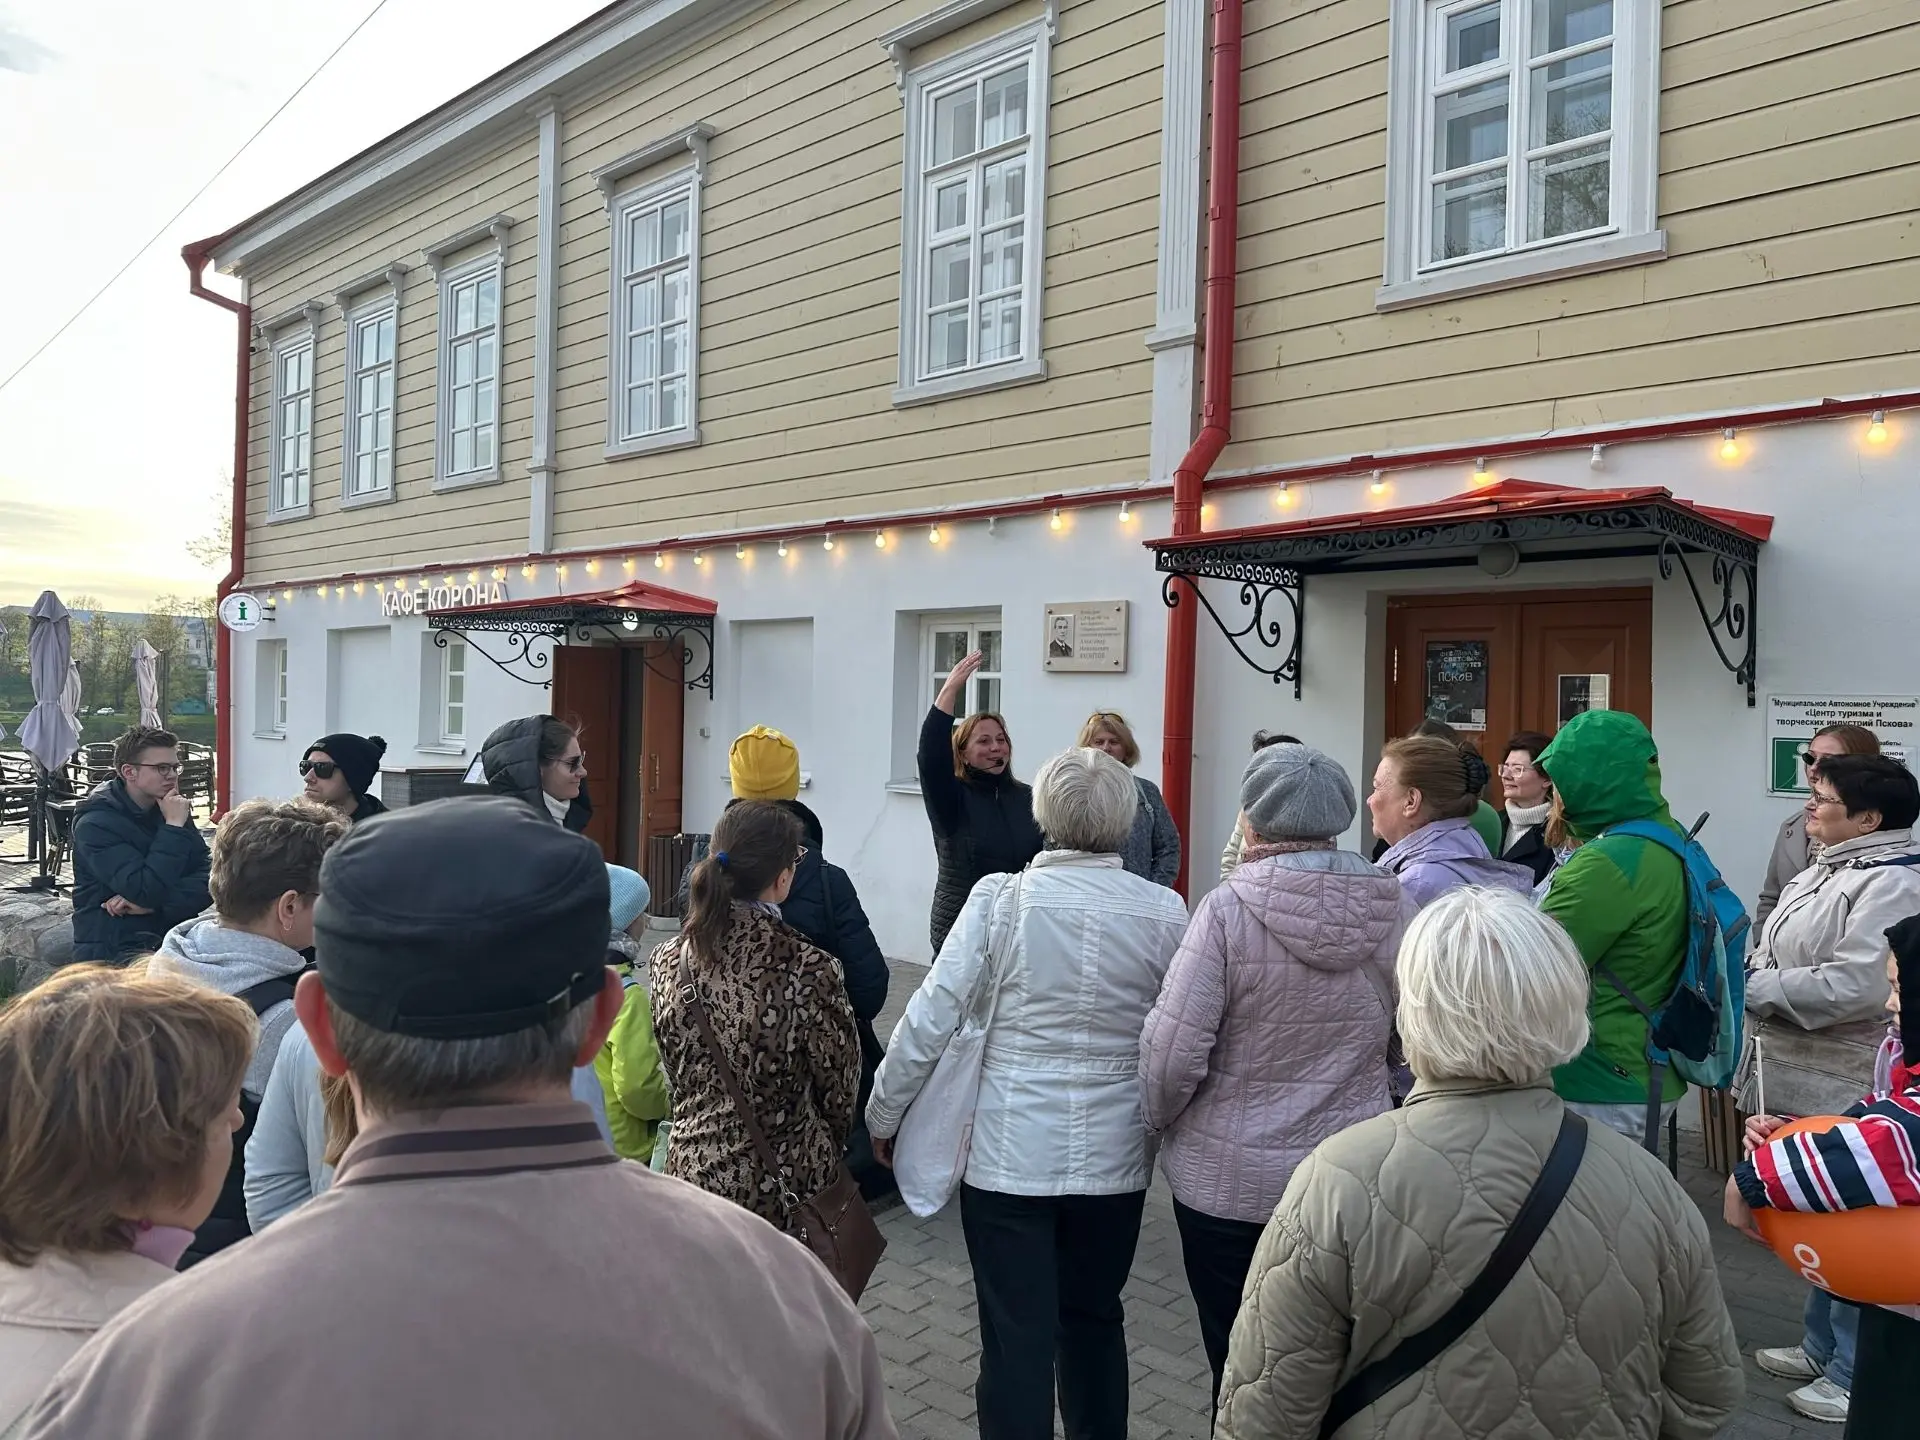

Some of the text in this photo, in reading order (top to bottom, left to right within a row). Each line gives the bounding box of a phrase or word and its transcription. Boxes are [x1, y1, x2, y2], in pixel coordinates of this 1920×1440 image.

[382, 582, 503, 617] КАФЕ КОРОНА
[1438, 671, 1473, 682] ПСКОВ
[1828, 700, 1872, 708] Автономное
[1805, 709, 1836, 718] «Центр
[1838, 710, 1874, 718] туризма
[1776, 719, 1825, 727] творческих
[1875, 720, 1914, 728] Пскова»
